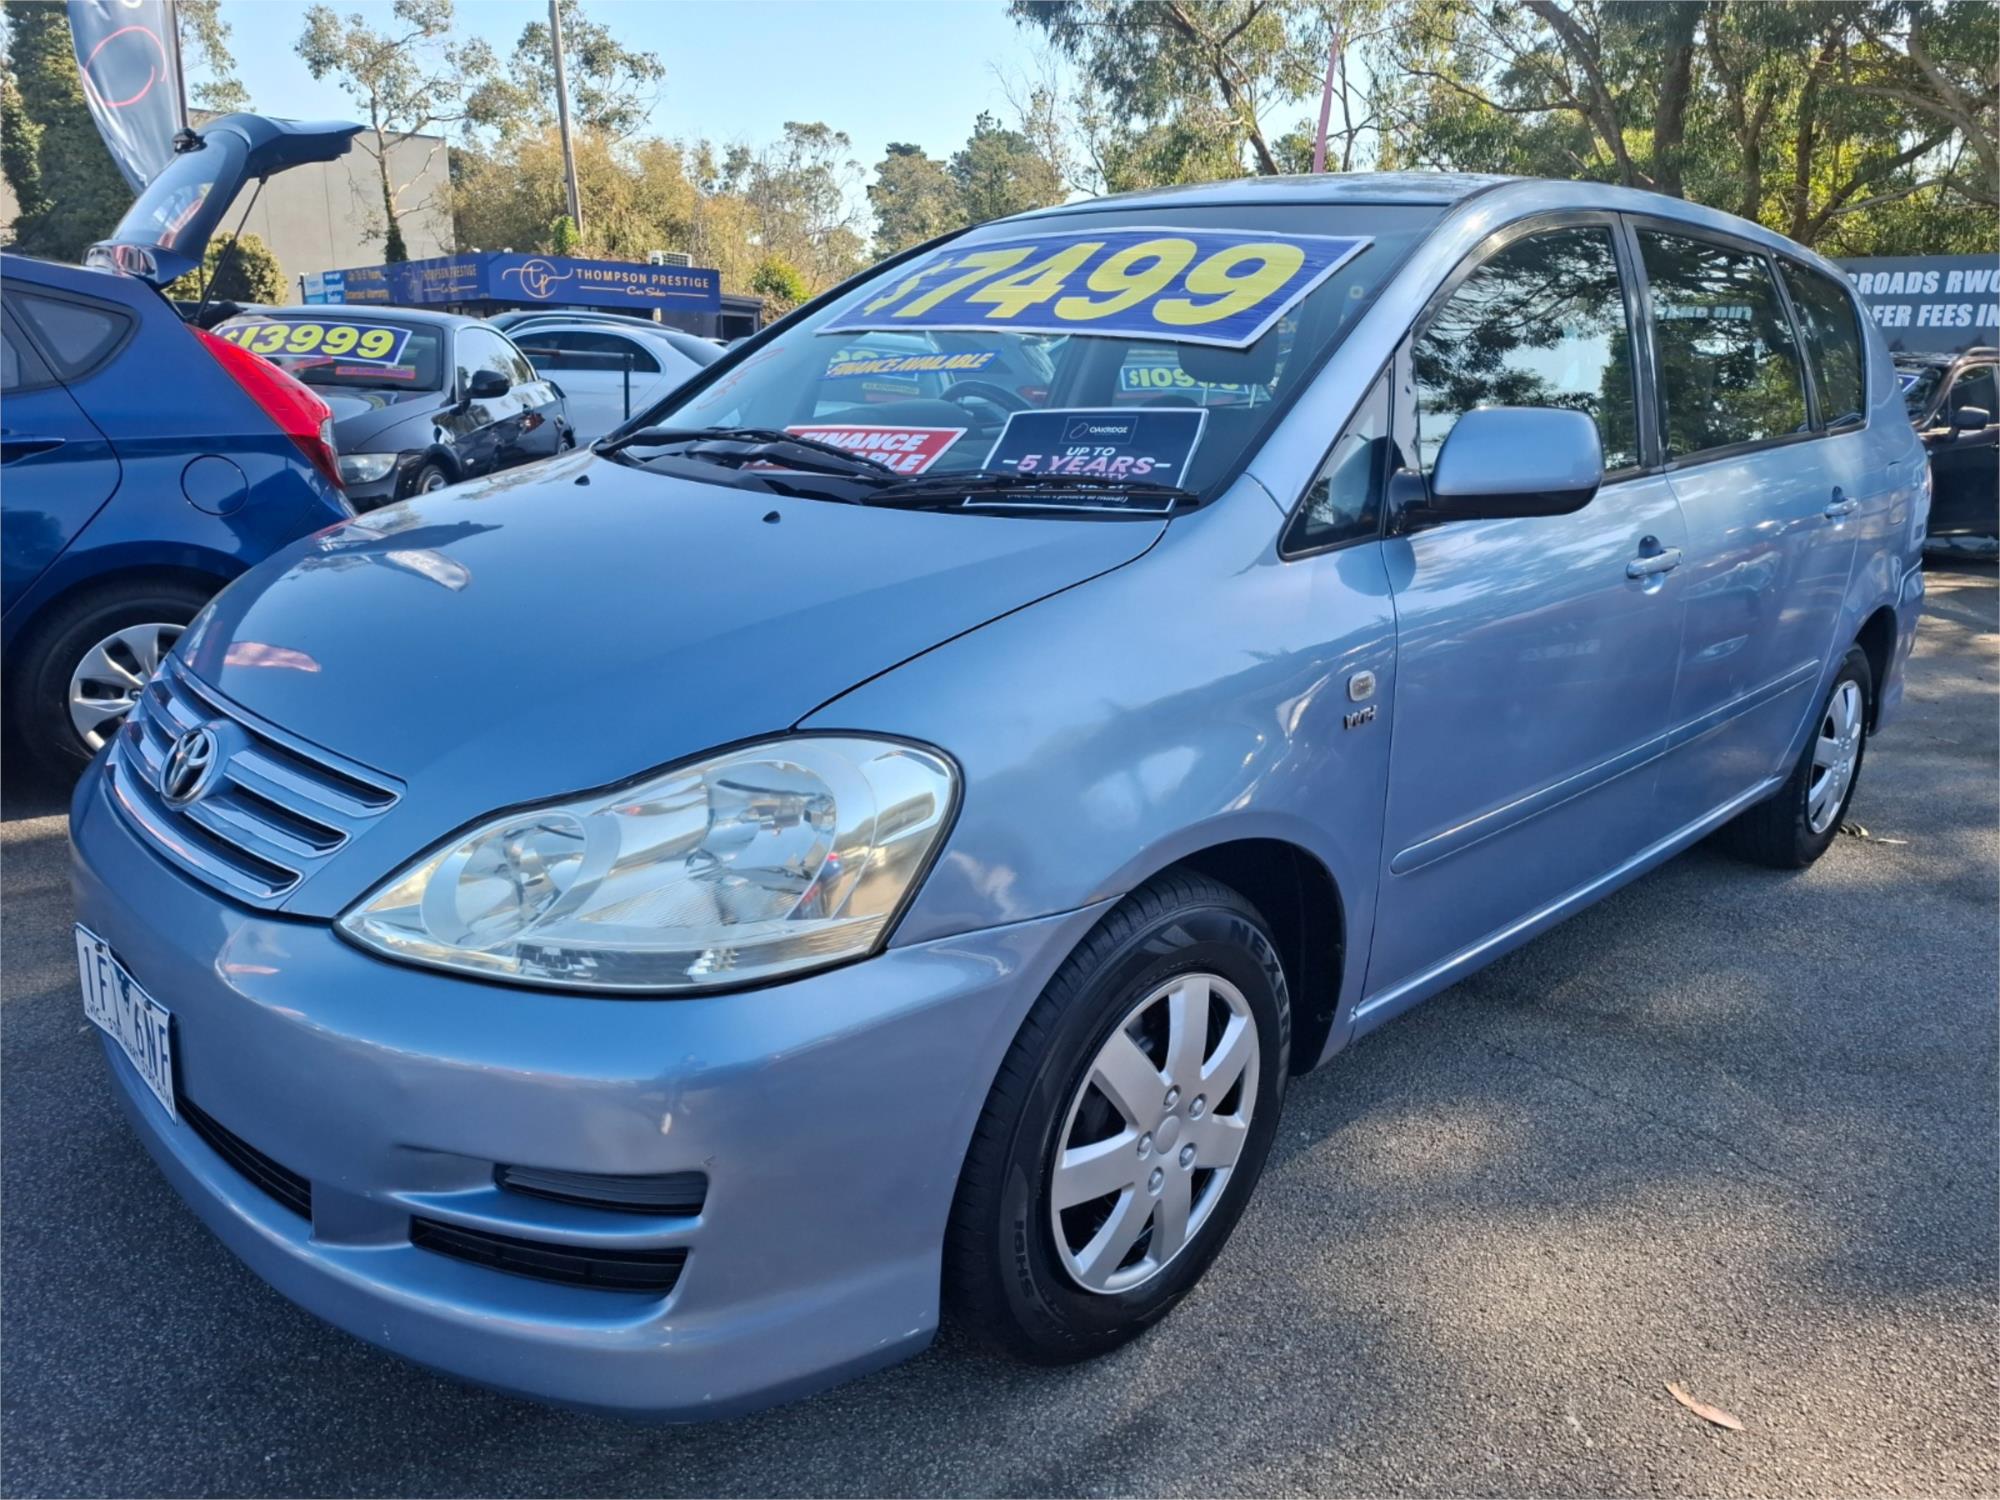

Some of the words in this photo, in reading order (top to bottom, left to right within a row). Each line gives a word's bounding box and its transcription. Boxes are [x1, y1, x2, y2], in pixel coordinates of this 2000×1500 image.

[575, 268, 648, 284] THOMPSON
[651, 274, 710, 289] PRESTIGE
[862, 238, 1306, 326] $7499
[626, 285, 645, 296] Car
[1916, 303, 1974, 328] FEES
[1065, 446, 1090, 457] UP
[1092, 446, 1116, 457] TO
